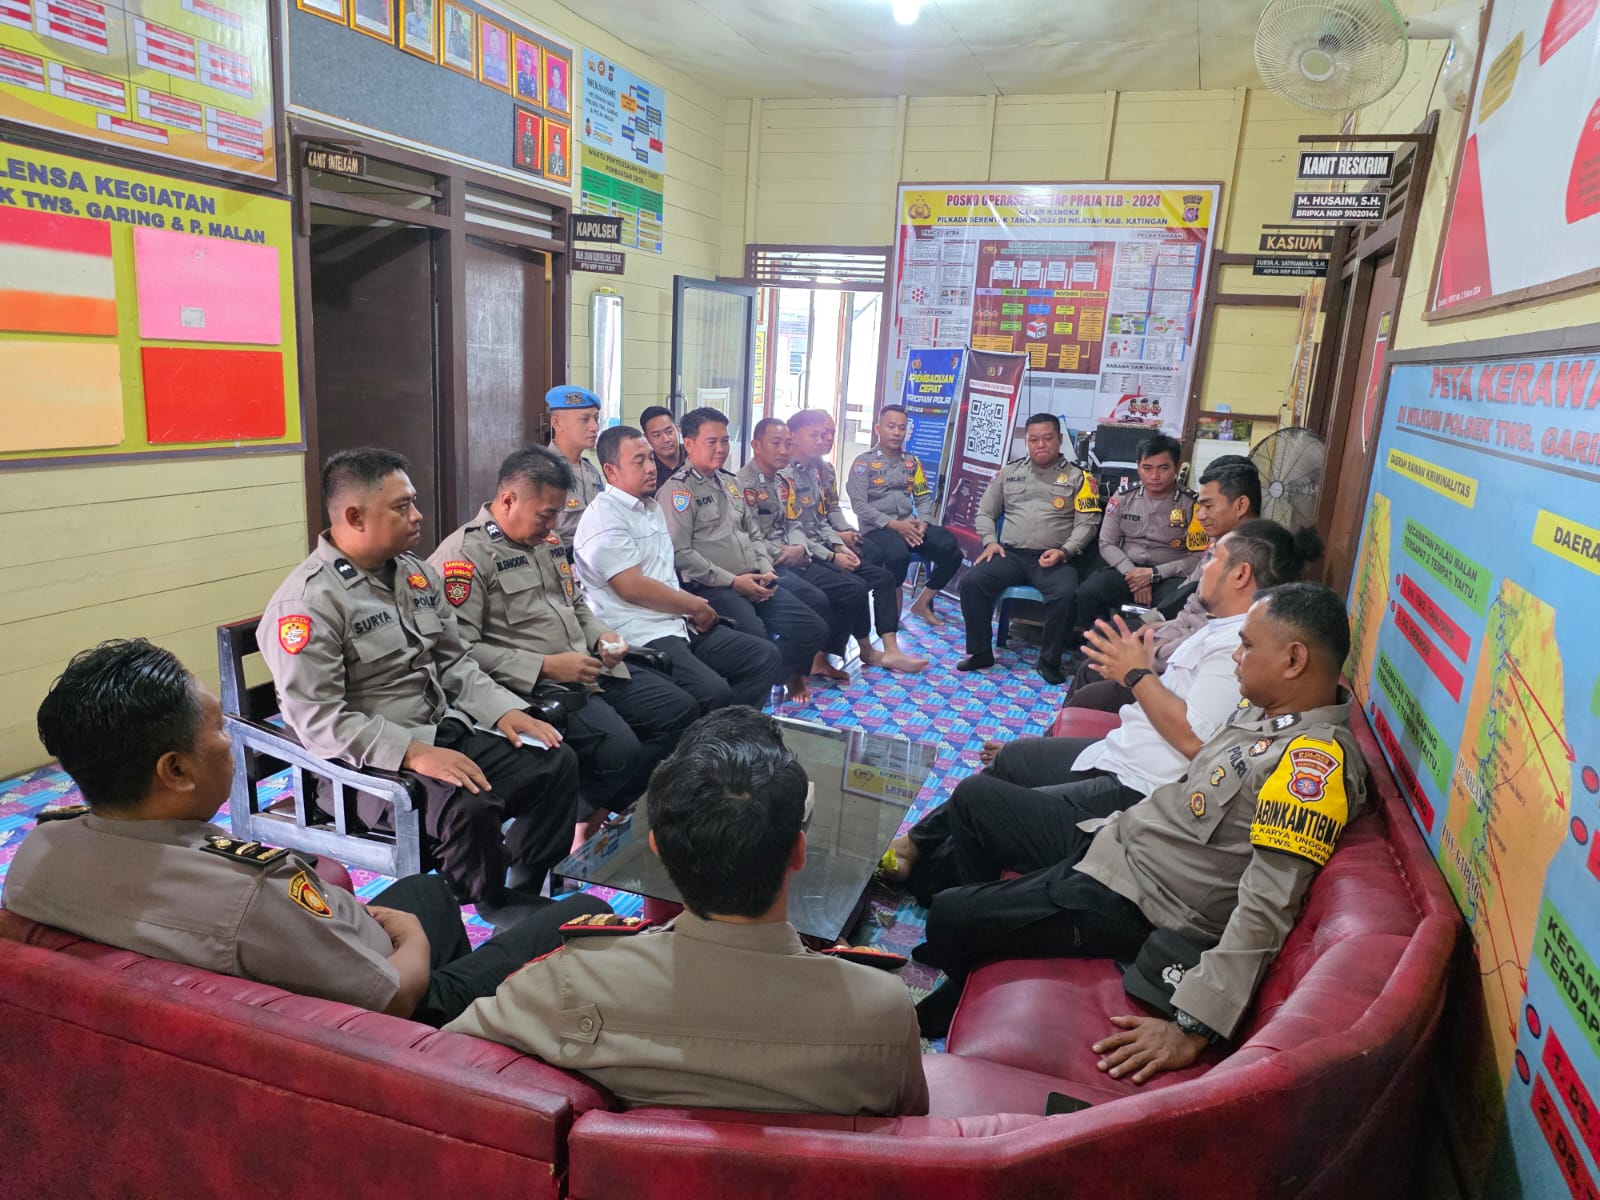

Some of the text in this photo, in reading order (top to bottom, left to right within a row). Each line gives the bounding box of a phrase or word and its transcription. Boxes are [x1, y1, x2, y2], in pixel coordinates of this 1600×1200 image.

[308, 151, 358, 174] KANIT INTELKAM
[1303, 156, 1389, 176] KANIT RESKRIM
[94, 175, 216, 215] KEGIATAN
[946, 194, 979, 207] POSKO
[1070, 194, 1102, 207] PRAJA
[1104, 195, 1124, 207] TLB
[1132, 194, 1161, 207] 2024
[1297, 196, 1381, 207] M. HUSAINI, S.H.
[21, 190, 80, 216] TWS.
[86, 202, 165, 229] GARING
[171, 216, 185, 232] &
[190, 219, 204, 234] P.
[209, 223, 266, 244] MALAN
[576, 221, 618, 239] KAPOLSEK
[1068, 217, 1102, 225] WILAYAH
[1296, 209, 1325, 217] BRIPKA
[1266, 235, 1323, 250] KASIUM
[919, 384, 943, 393] CEPAT
[1430, 366, 1474, 400] PETA
[1397, 406, 1406, 423] DI
[1406, 407, 1442, 431] WILKUM
[1443, 412, 1492, 442] POLSEK
[1496, 418, 1535, 452] TWS.
[1390, 453, 1471, 499] DAERAH RAWAN KRIMINALITAS
[1404, 535, 1427, 561] TERDAPAT
[1425, 554, 1431, 565] 2
[1454, 575, 1474, 599] YAITU
[1406, 523, 1478, 582] KECAMATAN PULAU MALAN
[353, 610, 393, 634] SURYA
[1380, 656, 1404, 697] KECAMATAN
[1415, 711, 1438, 751] GARING
[1227, 745, 1247, 779] POLRI
[1419, 738, 1437, 771] YAITU
[1260, 826, 1290, 839] KARYA
[1268, 836, 1292, 848] TWS.
[1455, 849, 1480, 899] GARING
[1547, 915, 1600, 1007] KECAM
[1543, 937, 1600, 1045] TERDAP
[1552, 1051, 1592, 1136] 1. DS.
[1538, 1098, 1580, 1189] 2. DS.
